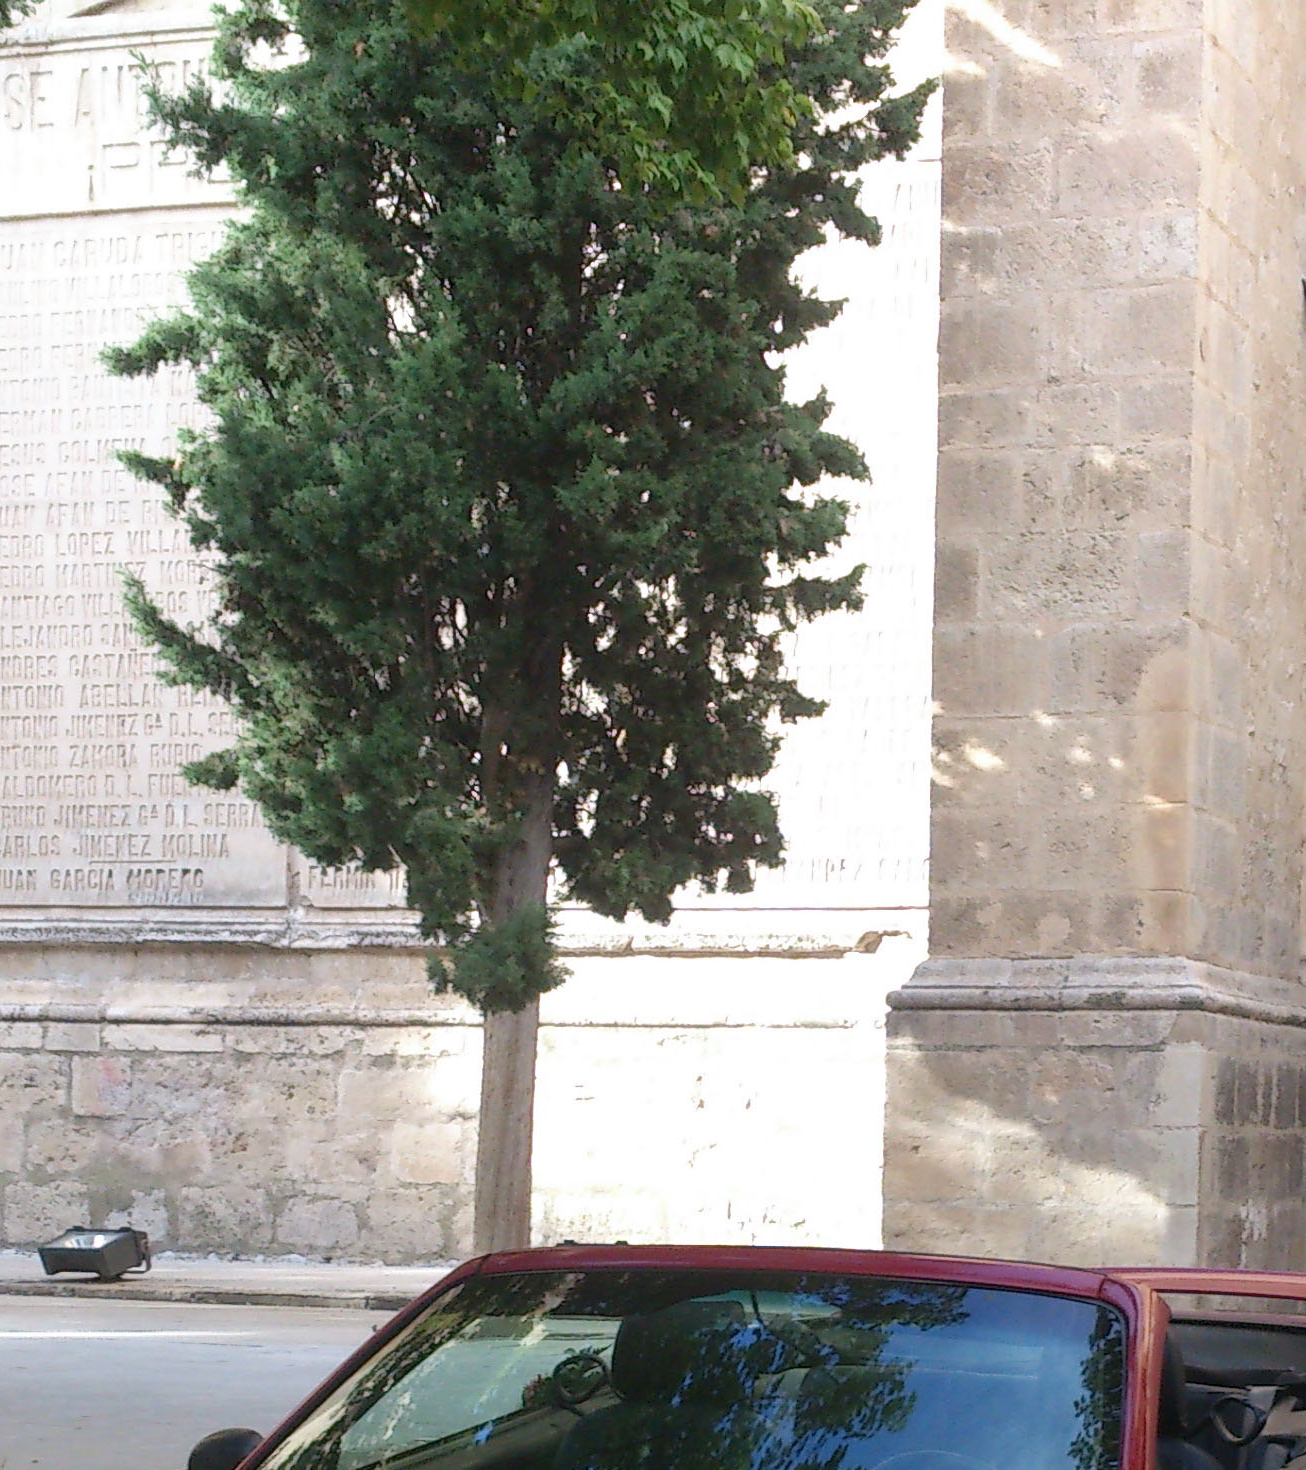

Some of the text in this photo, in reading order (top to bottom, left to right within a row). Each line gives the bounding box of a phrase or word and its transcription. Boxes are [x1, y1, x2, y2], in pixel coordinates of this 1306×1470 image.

[101, 468, 127, 493] DE
[105, 501, 131, 525] DE
[54, 531, 115, 556] LOPEZ
[55, 561, 147, 590] MARTINZ
[66, 714, 139, 739] JIMENEZ
[68, 744, 139, 769] ZAMORA
[54, 804, 132, 829] JIMENEZ
[72, 834, 152, 858] JIMENEZ
[161, 833, 230, 858] MOLINA
[49, 868, 115, 891] GARCIA
[125, 868, 205, 891] MORENO
